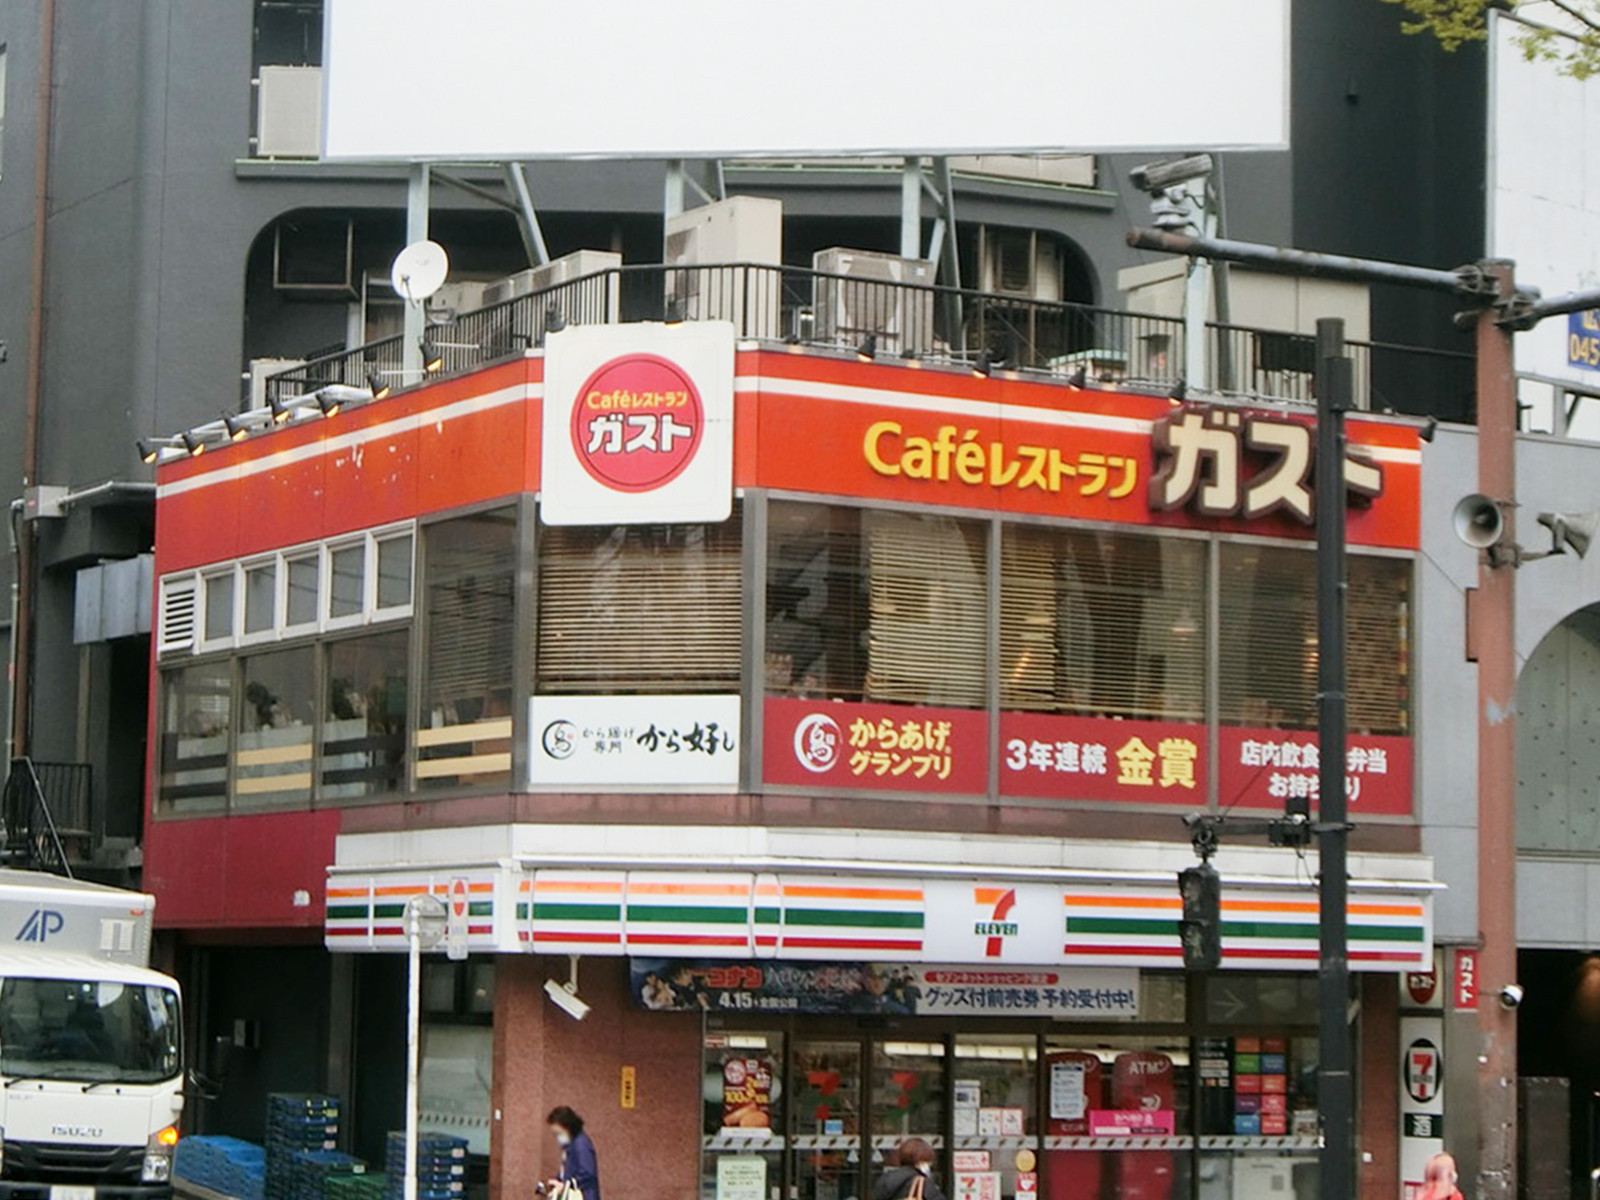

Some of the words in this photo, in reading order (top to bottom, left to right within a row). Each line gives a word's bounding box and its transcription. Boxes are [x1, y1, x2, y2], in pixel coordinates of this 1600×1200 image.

[587, 412, 692, 454] ガスト
[863, 420, 1137, 498] Caféレストラン
[637, 722, 735, 755] から好し
[849, 717, 951, 751] からあげ
[849, 750, 951, 780] グランプリ
[1006, 739, 1107, 774] 3年連続
[1115, 736, 1198, 789] 金賞
[1268, 772, 1361, 801] お持ちり
[719, 992, 750, 1008] 4.15
